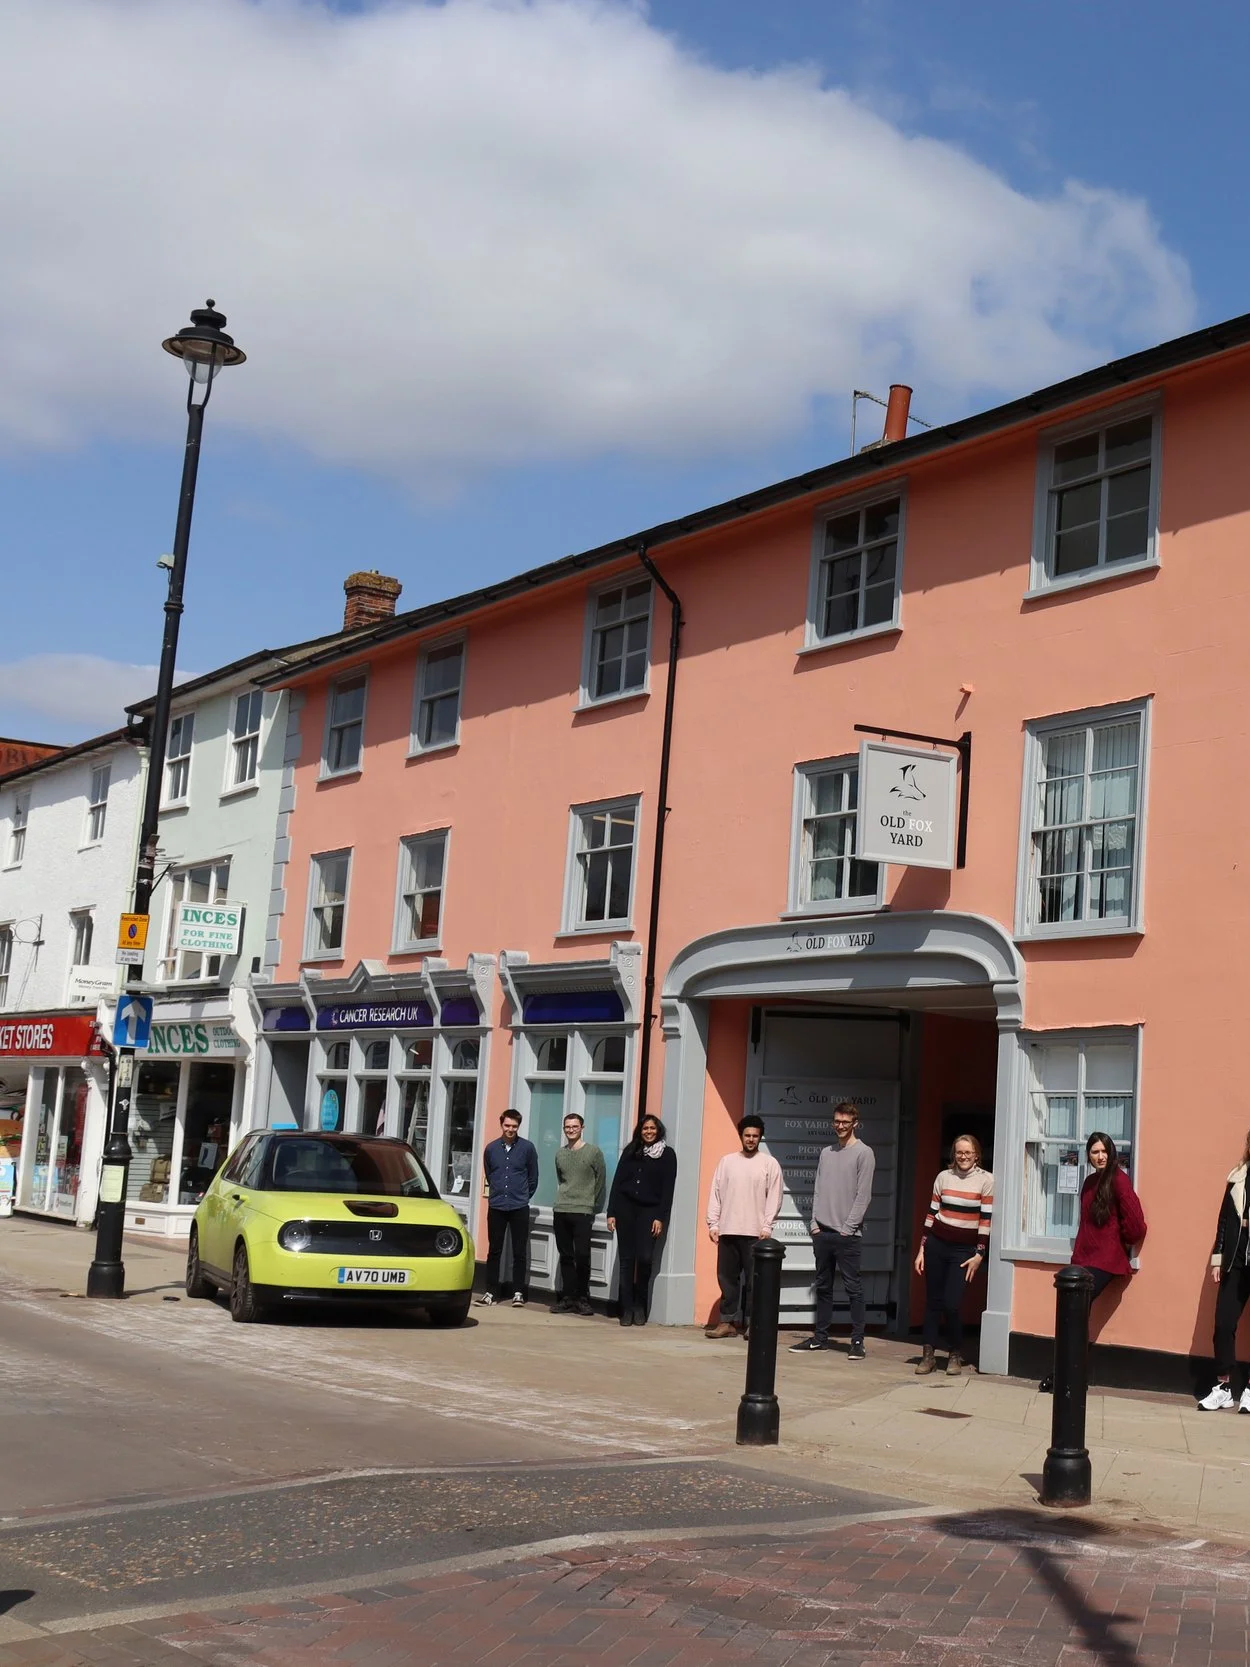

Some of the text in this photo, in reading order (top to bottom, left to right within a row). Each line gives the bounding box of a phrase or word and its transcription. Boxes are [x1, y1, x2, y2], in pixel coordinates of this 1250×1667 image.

[880, 815, 932, 832] OLD FOX
[890, 832, 923, 847] YARD
[183, 909, 237, 926] INCES
[183, 929, 233, 940] FOR FINE
[806, 933, 875, 949] OLD FOX YARD
[181, 939, 233, 950] CLOTHING
[75, 978, 112, 986] MoneyGram
[340, 1006, 418, 1023] CANCER RESEARCH UK
[15, 1024, 54, 1049] STORES
[214, 1039, 241, 1048] CLOTHING
[809, 1095, 877, 1105] OLD FOX YARD
[785, 1120, 803, 1128] FOX
[804, 1120, 829, 1129] YARD
[346, 1270, 406, 1283] AV70 UMB
